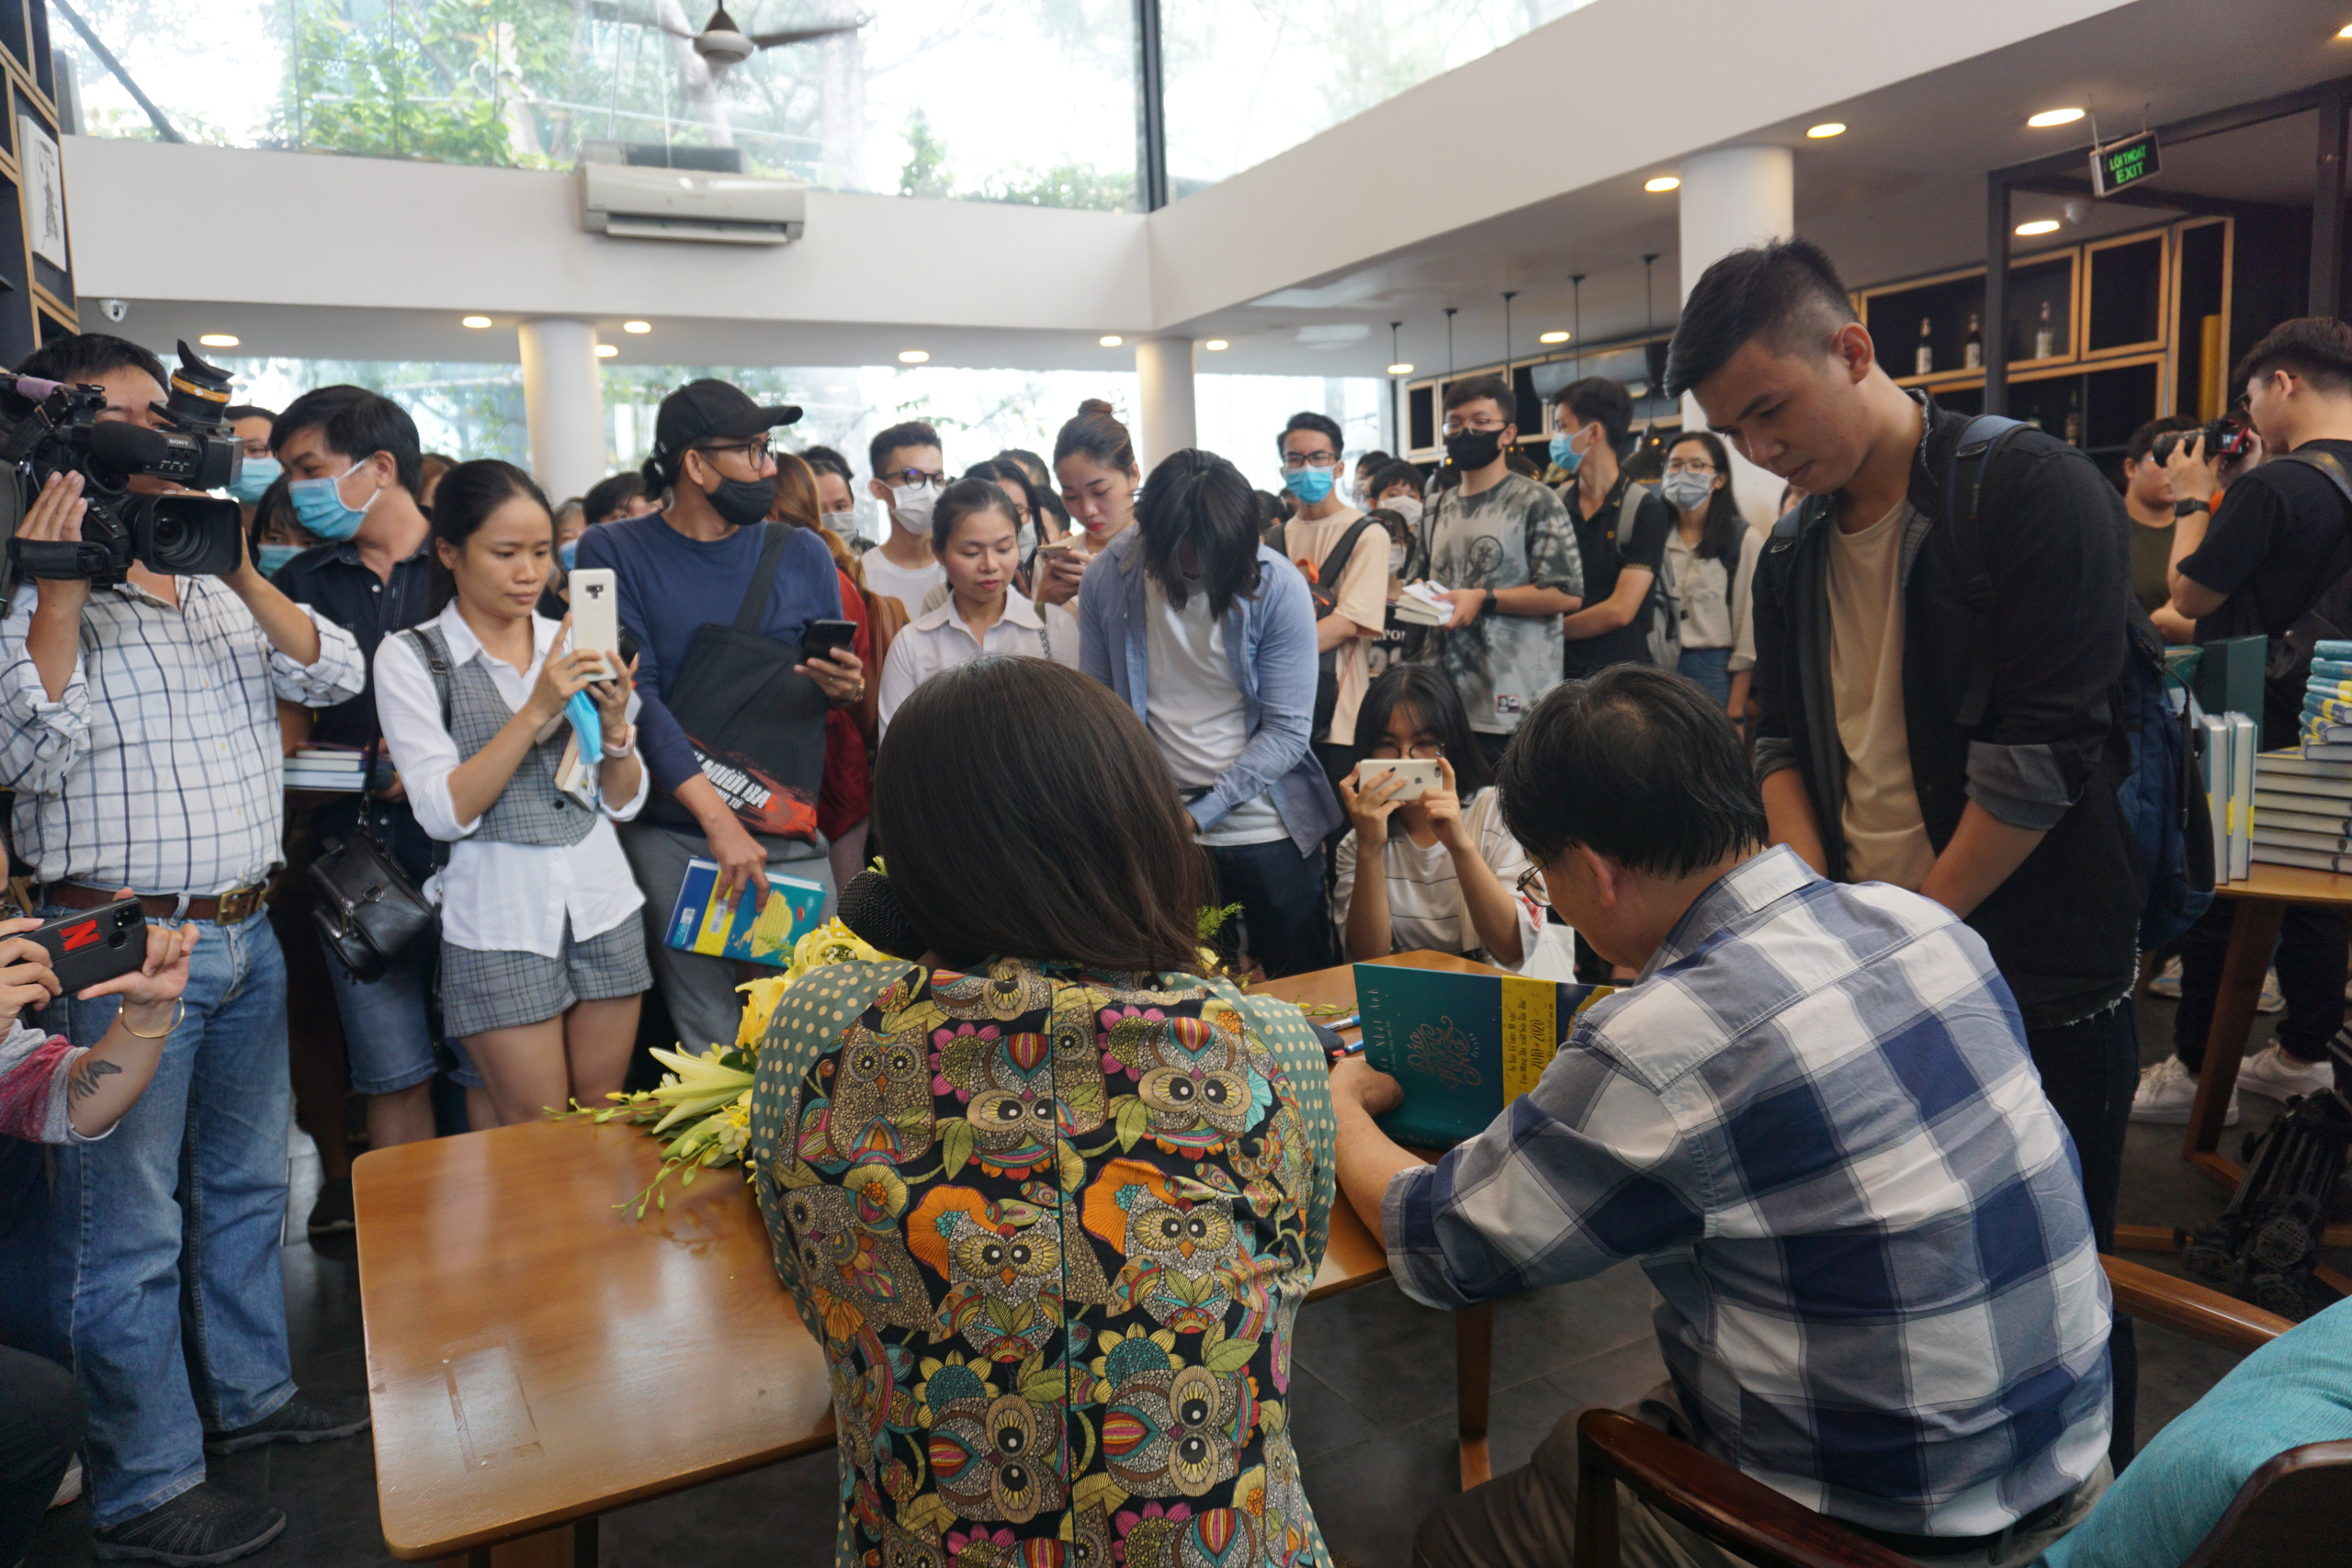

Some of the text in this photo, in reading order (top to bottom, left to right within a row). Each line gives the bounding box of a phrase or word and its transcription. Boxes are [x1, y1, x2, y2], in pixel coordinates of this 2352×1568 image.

[2116, 161, 2143, 184] EXIT
[168, 438, 188, 446] SONY
[1530, 1018, 1544, 1071] 2010 2020
